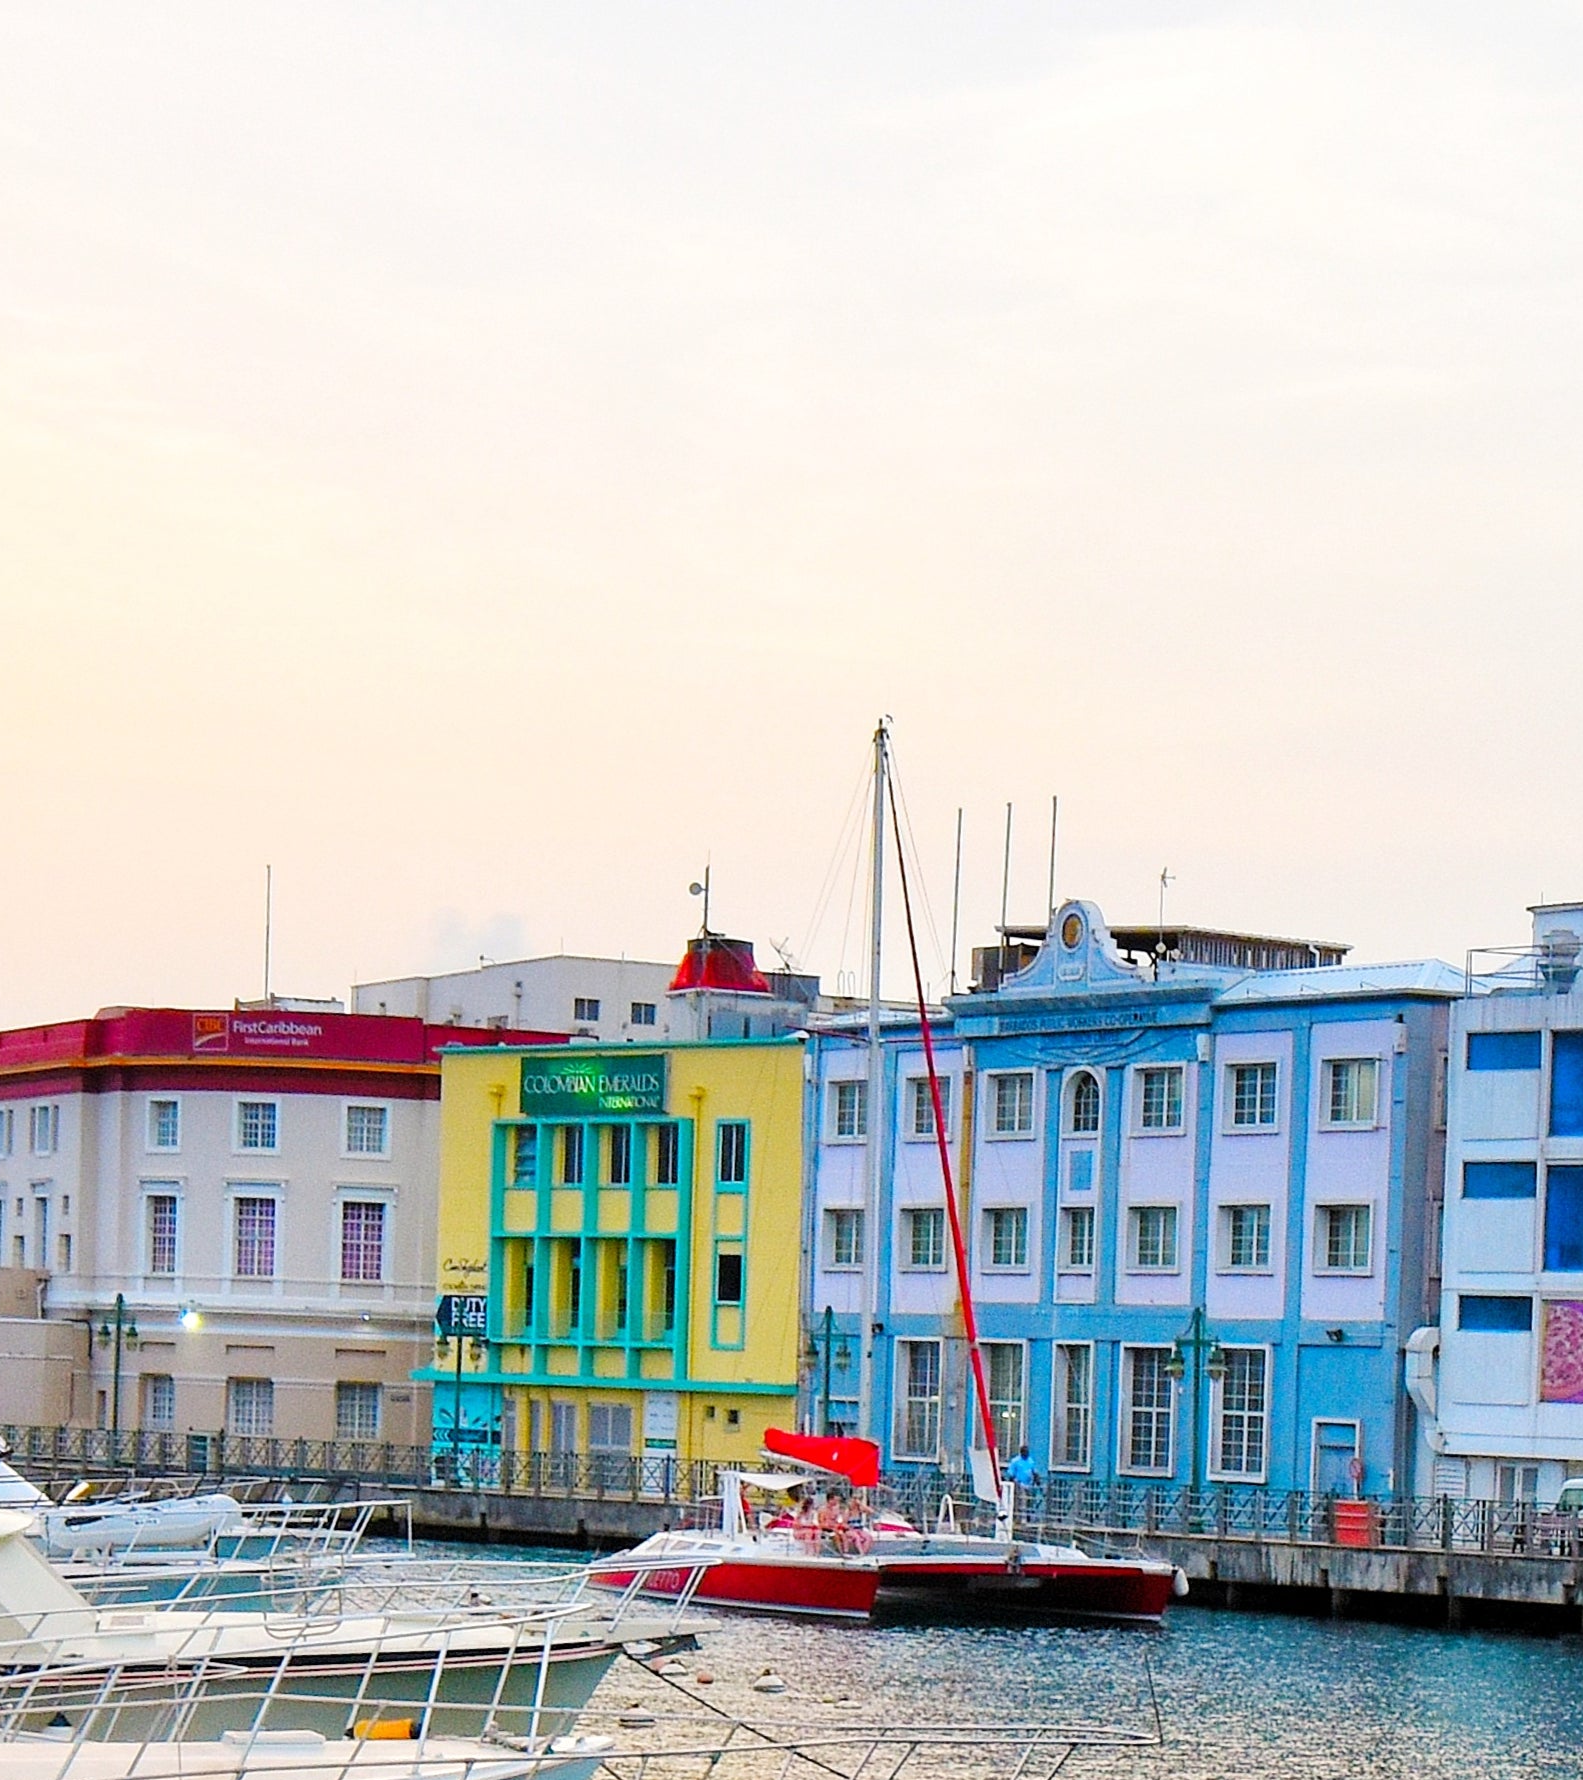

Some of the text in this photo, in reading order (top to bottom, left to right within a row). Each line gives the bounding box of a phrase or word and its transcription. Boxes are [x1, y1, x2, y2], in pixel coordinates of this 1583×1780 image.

[233, 1020, 322, 1036] FirstCaribbean
[244, 1037, 310, 1047] International Bank
[523, 1073, 660, 1094] COLOMBIAN EMERALDS
[598, 1095, 658, 1109] INTERNATIONAL
[451, 1297, 487, 1312] DUTY
